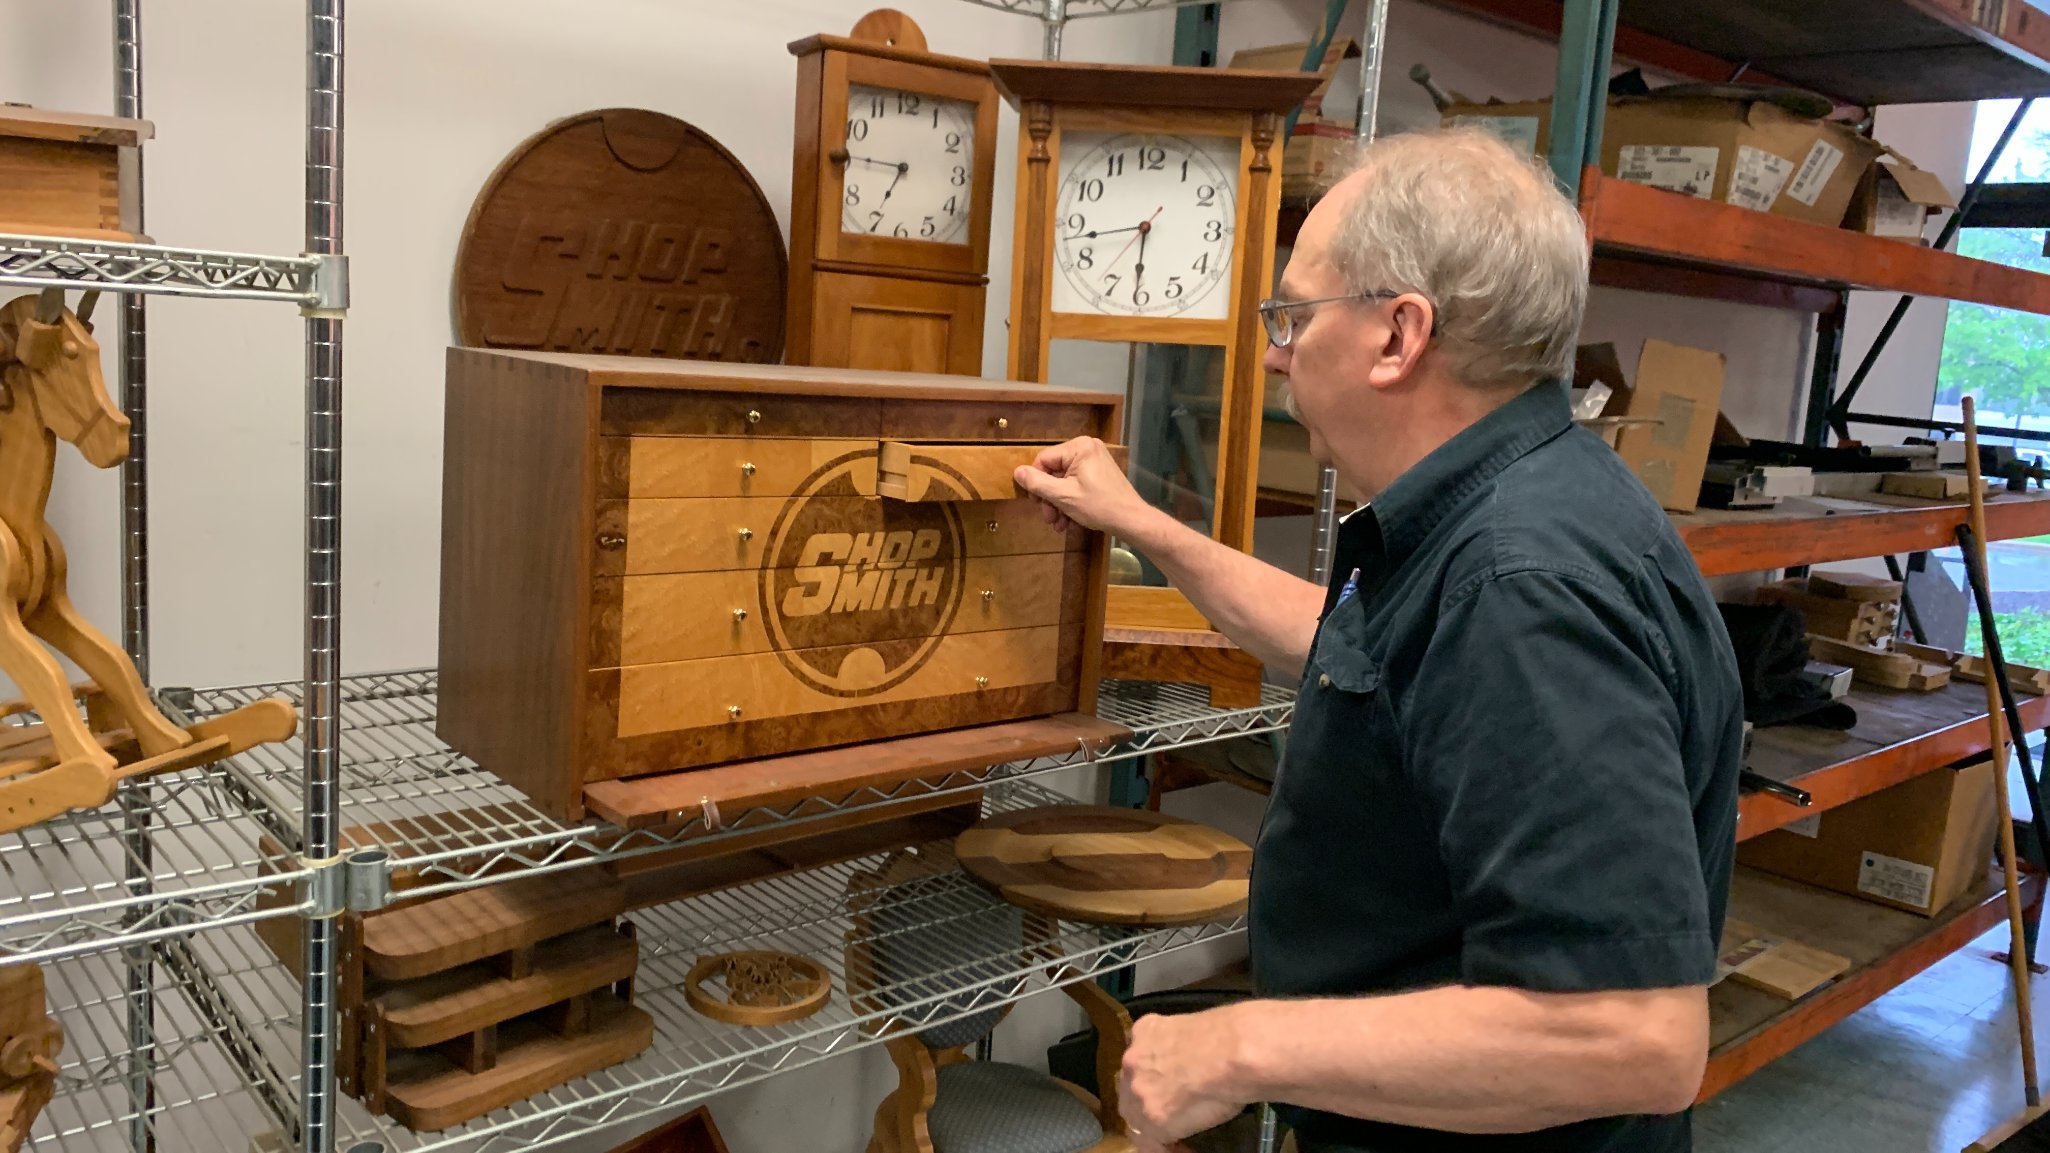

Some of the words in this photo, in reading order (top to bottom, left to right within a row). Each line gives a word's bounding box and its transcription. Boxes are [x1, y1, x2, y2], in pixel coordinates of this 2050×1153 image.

[870, 96, 885, 119] 11
[897, 93, 920, 116] 12
[932, 107, 939, 129] 1
[847, 118, 868, 142] 10
[945, 132, 960, 154] 2
[1107, 153, 1124, 178] 11
[1138, 146, 1166, 171] 12
[950, 165, 966, 187] 3
[1181, 159, 1188, 183] 1
[845, 184, 860, 206] 8
[1078, 178, 1104, 202] 10
[1196, 185, 1215, 207] 2
[942, 195, 956, 216] 4
[869, 210, 885, 233] 7
[893, 222, 908, 238] 6
[920, 216, 935, 237] 5
[1068, 213, 1086, 239] 9
[1203, 220, 1222, 243] 3
[1077, 247, 1094, 271] 8
[1191, 251, 1209, 275] 4
[1103, 274, 1122, 297] 7
[1132, 283, 1150, 307] 6
[1164, 276, 1183, 299] 5
[796, 529, 941, 571] SHOP
[782, 565, 945, 617] SMITH
